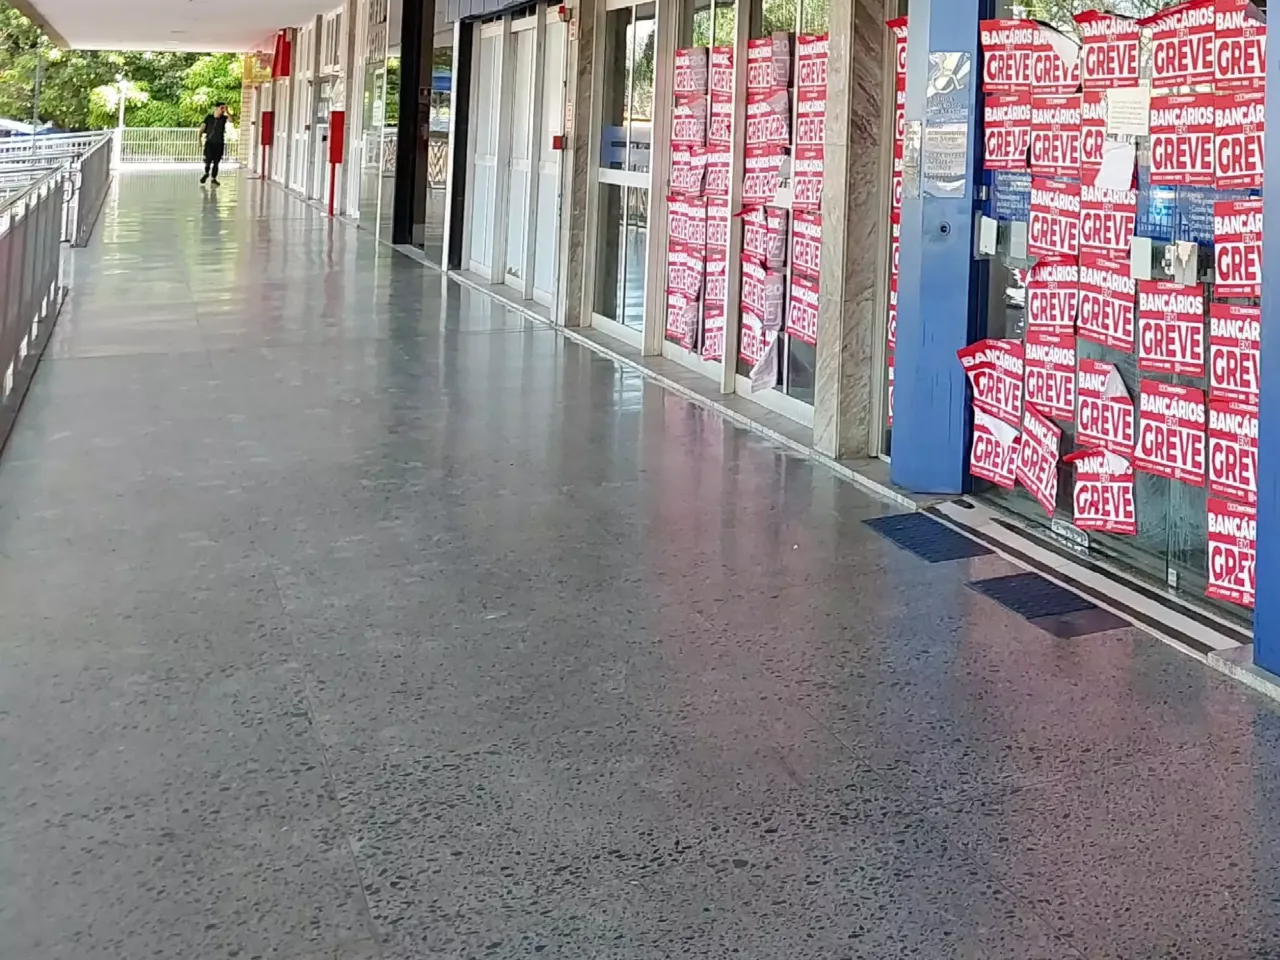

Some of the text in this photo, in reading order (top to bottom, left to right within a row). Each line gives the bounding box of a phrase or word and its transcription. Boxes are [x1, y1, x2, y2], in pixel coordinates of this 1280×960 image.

[801, 61, 826, 84] GREVE
[986, 53, 1030, 81] GREVE
[1085, 43, 1137, 76] GREVE
[1154, 36, 1213, 75] GREVE
[1217, 39, 1266, 76] GREV
[799, 119, 824, 142] GREVE
[1215, 103, 1264, 128] BANCÁR
[986, 129, 1028, 157] GREVE
[1033, 133, 1079, 164] GREVE
[1152, 135, 1213, 170] GREVE
[1031, 214, 1077, 252] GREVE
[1081, 212, 1134, 247] GREVE
[1214, 213, 1263, 235] BANCÁR
[1031, 291, 1076, 322] GREVE
[1081, 294, 1133, 338] GREVE
[1141, 321, 1201, 360] GREVE
[1210, 318, 1260, 341] BANCÁR
[1212, 348, 1259, 387] GREV
[973, 370, 1020, 413] GREVE
[1027, 368, 1073, 408] GREVE
[1024, 412, 1058, 452] BANCÁR
[1079, 399, 1132, 441] GREVE
[1209, 410, 1258, 438] BANCÁR
[973, 434, 1018, 476] GREVE
[1141, 423, 1201, 471] GREVE
[1212, 441, 1257, 487] GREV
[1075, 484, 1133, 519] GREVE
[1208, 511, 1256, 539] BANCÁR
